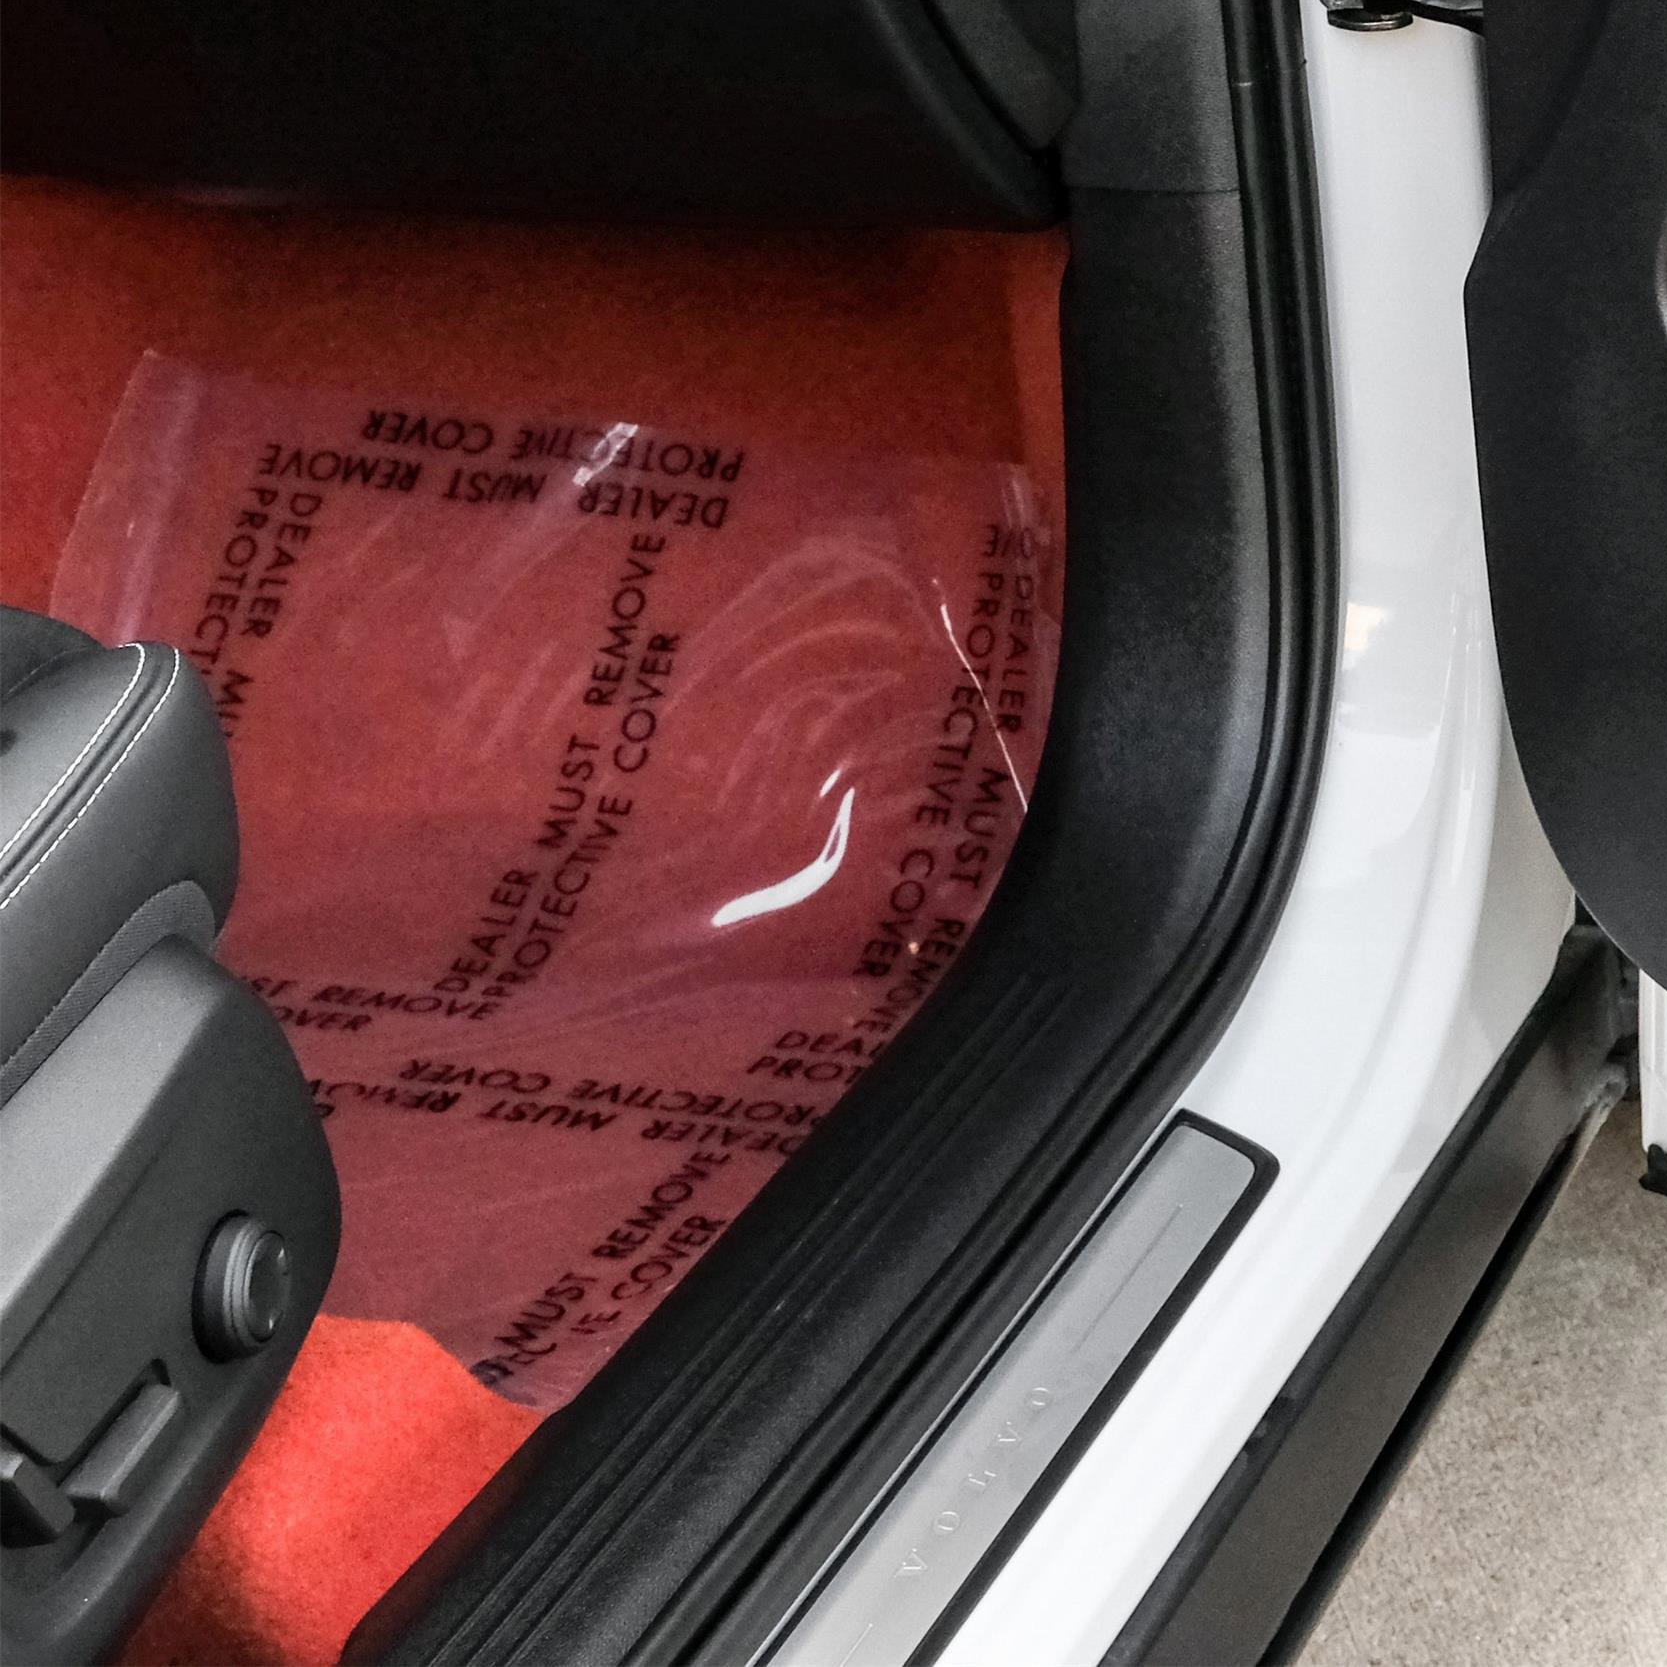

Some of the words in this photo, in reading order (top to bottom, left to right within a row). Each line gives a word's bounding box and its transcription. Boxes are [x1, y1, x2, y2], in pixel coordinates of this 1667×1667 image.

[258, 444, 422, 492] REMOVE
[361, 409, 494, 454] COVER
[443, 468, 547, 504] MUST
[241, 492, 324, 639] DEALER
[577, 482, 730, 529] DEALER
[190, 486, 279, 676] PROTECT
[916, 571, 1004, 828] PROTECTIVE
[999, 574, 1033, 736] DEALER
[433, 867, 539, 994] DEALER
[537, 734, 601, 852] MUST
[583, 534, 667, 707] REMOVE
[481, 794, 634, 999] PROTECTIVE
[613, 632, 681, 774] COVER
[949, 766, 1010, 889] MUST
[852, 848, 935, 978] COVER
[272, 1005, 373, 1031] OVER
[311, 985, 500, 1020] REMOVE
[400, 1059, 551, 1094] COVER
[475, 1099, 619, 1132] MUST
[495, 1273, 599, 1347] MUST
[591, 1152, 732, 1260] REMOVE
[611, 1215, 727, 1301] COVER
[899, 1386, 1052, 1574] VOLVO
